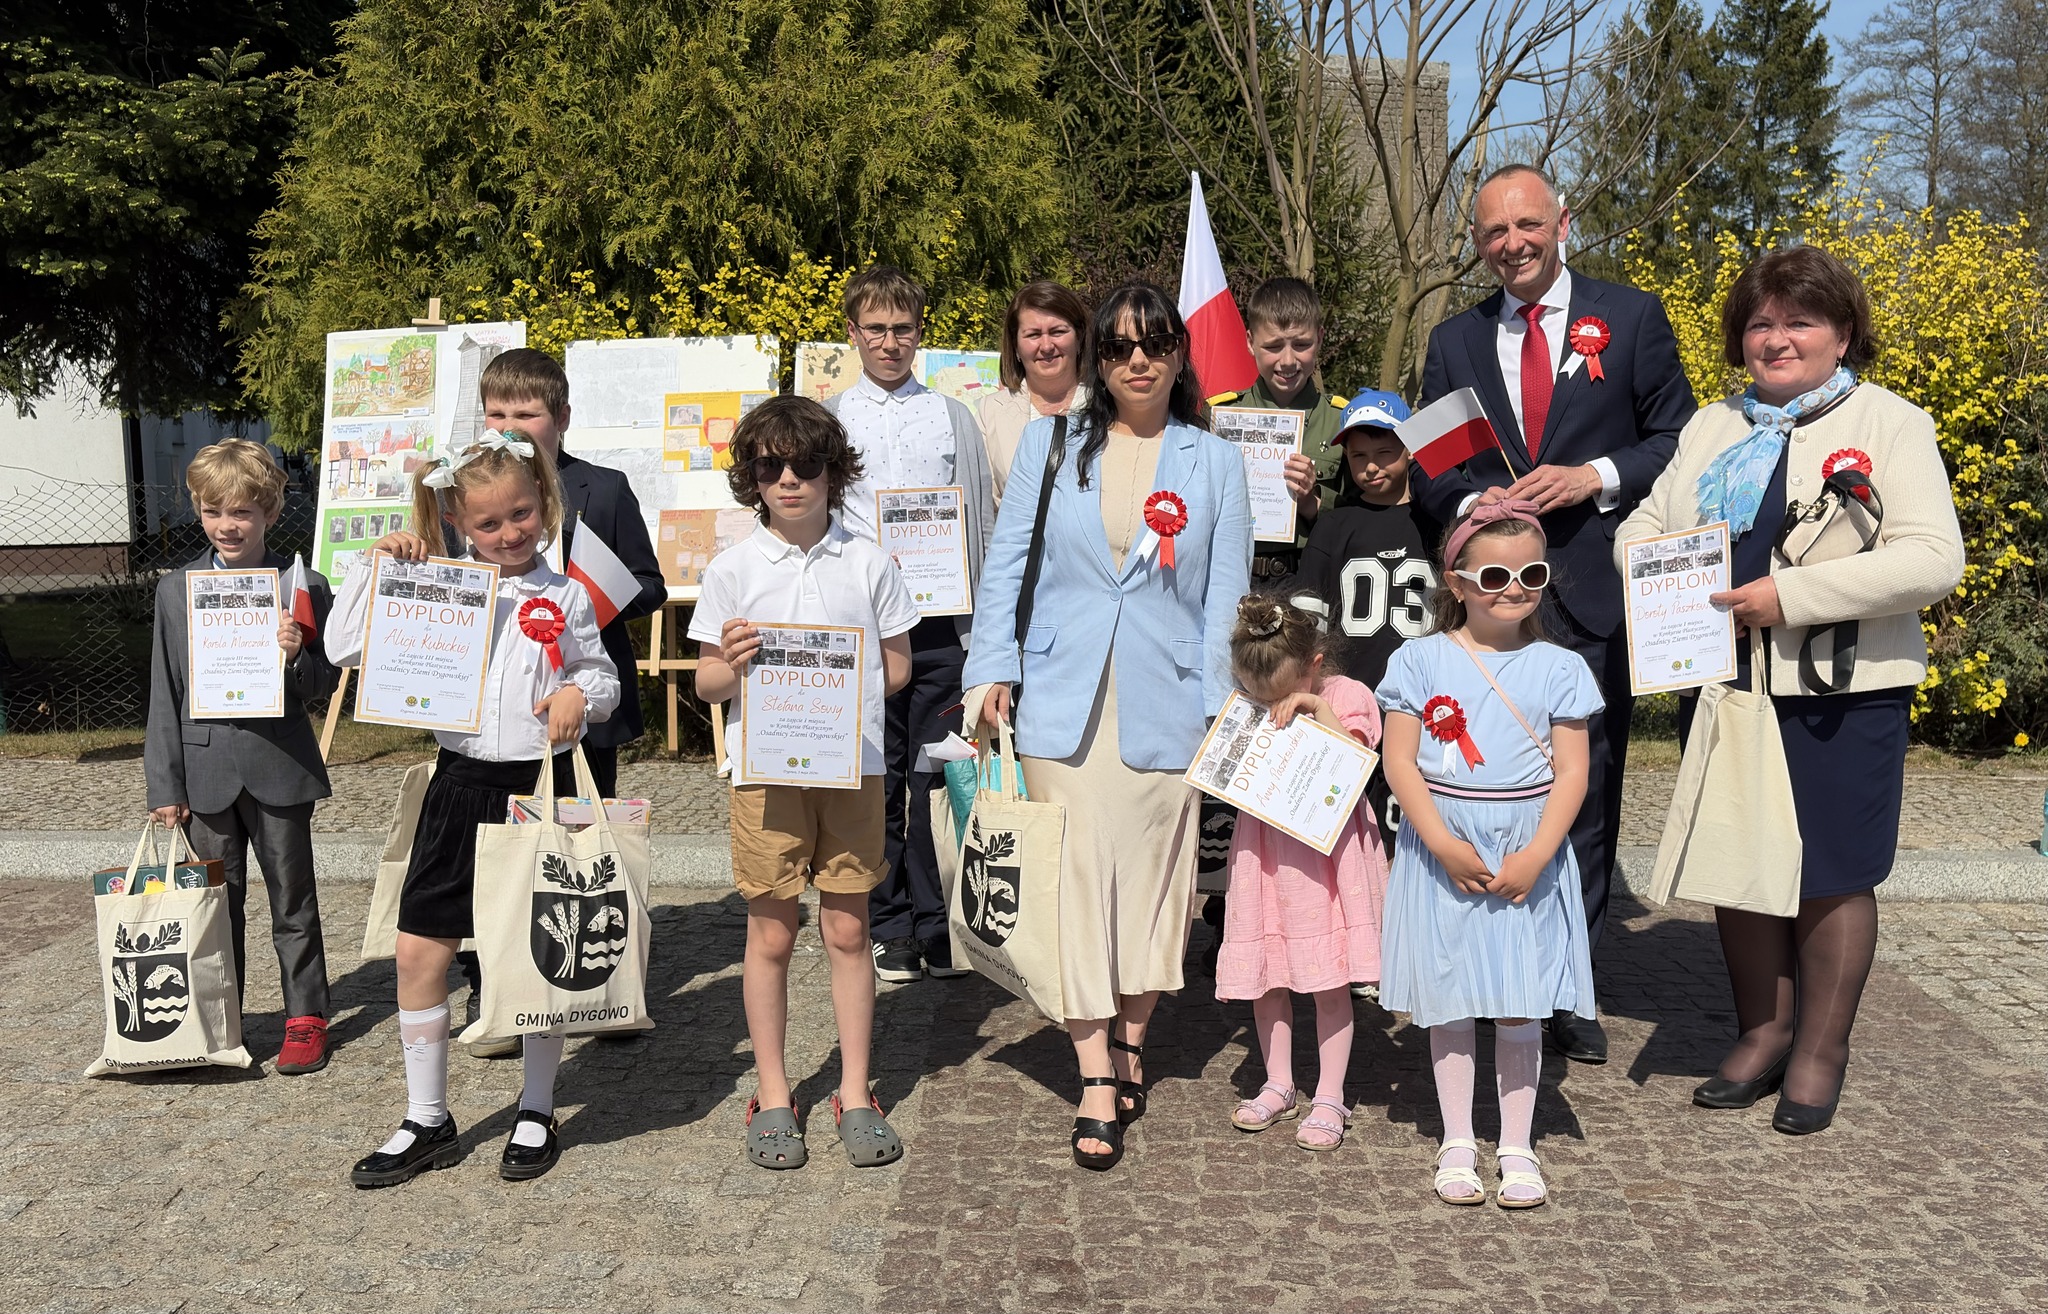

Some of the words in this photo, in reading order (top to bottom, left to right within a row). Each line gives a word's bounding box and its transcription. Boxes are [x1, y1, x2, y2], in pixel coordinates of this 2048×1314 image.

[1241, 445, 1286, 460] PLOM
[890, 524, 951, 539] DYPLOM
[1641, 570, 1717, 596] DYPLOM
[1340, 557, 1438, 639] 03
[203, 612, 268, 626] DYPLOM
[387, 602, 474, 626] DYPLOM
[384, 629, 417, 653] Alicji
[421, 634, 470, 659] Kubickiej
[1672, 635, 1688, 643] Ziemi
[412, 668, 431, 676] Ziemi
[425, 662, 457, 671] Plastycznym
[761, 670, 844, 688] DYPLOM
[762, 695, 804, 712] Stefana
[810, 697, 843, 721] Sowy
[1233, 721, 1278, 791] DYPLOM
[1302, 775, 1313, 792] Ziemi
[965, 942, 992, 963] GMINA
[992, 958, 1028, 988] DYGOWO
[515, 1013, 564, 1026] GMINA
[569, 1005, 628, 1022] DYGOWO
[104, 1058, 145, 1069] GMINA
